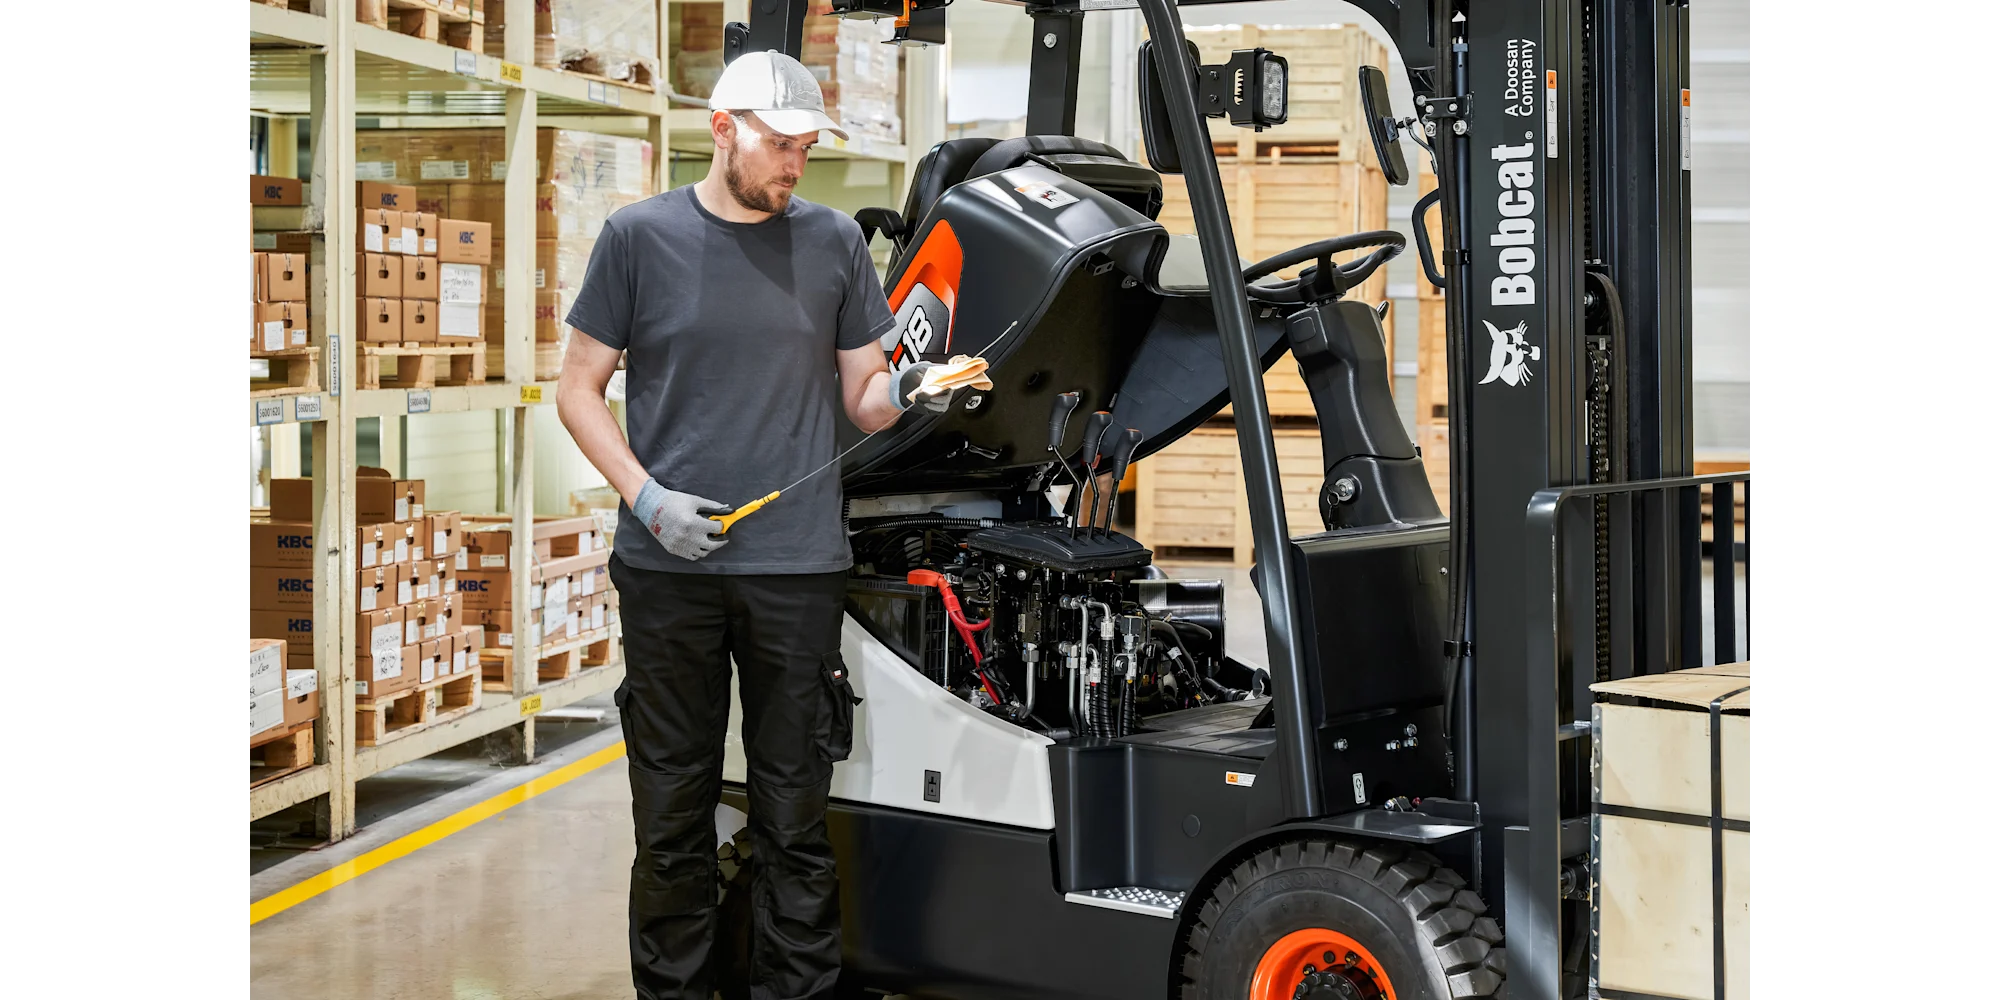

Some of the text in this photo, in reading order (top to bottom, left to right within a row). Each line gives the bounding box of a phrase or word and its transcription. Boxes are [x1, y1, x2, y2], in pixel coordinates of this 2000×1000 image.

[1504, 39, 1519, 117] A Doosan
[1519, 39, 1537, 117] Company
[264, 185, 282, 199] KBC
[381, 193, 398, 206] KBC
[1491, 143, 1536, 306] Bobcat
[459, 231, 475, 244] KBC
[891, 305, 933, 371] 18
[277, 535, 313, 548] KBC
[278, 578, 313, 592] KBC
[457, 580, 490, 592] KBC
